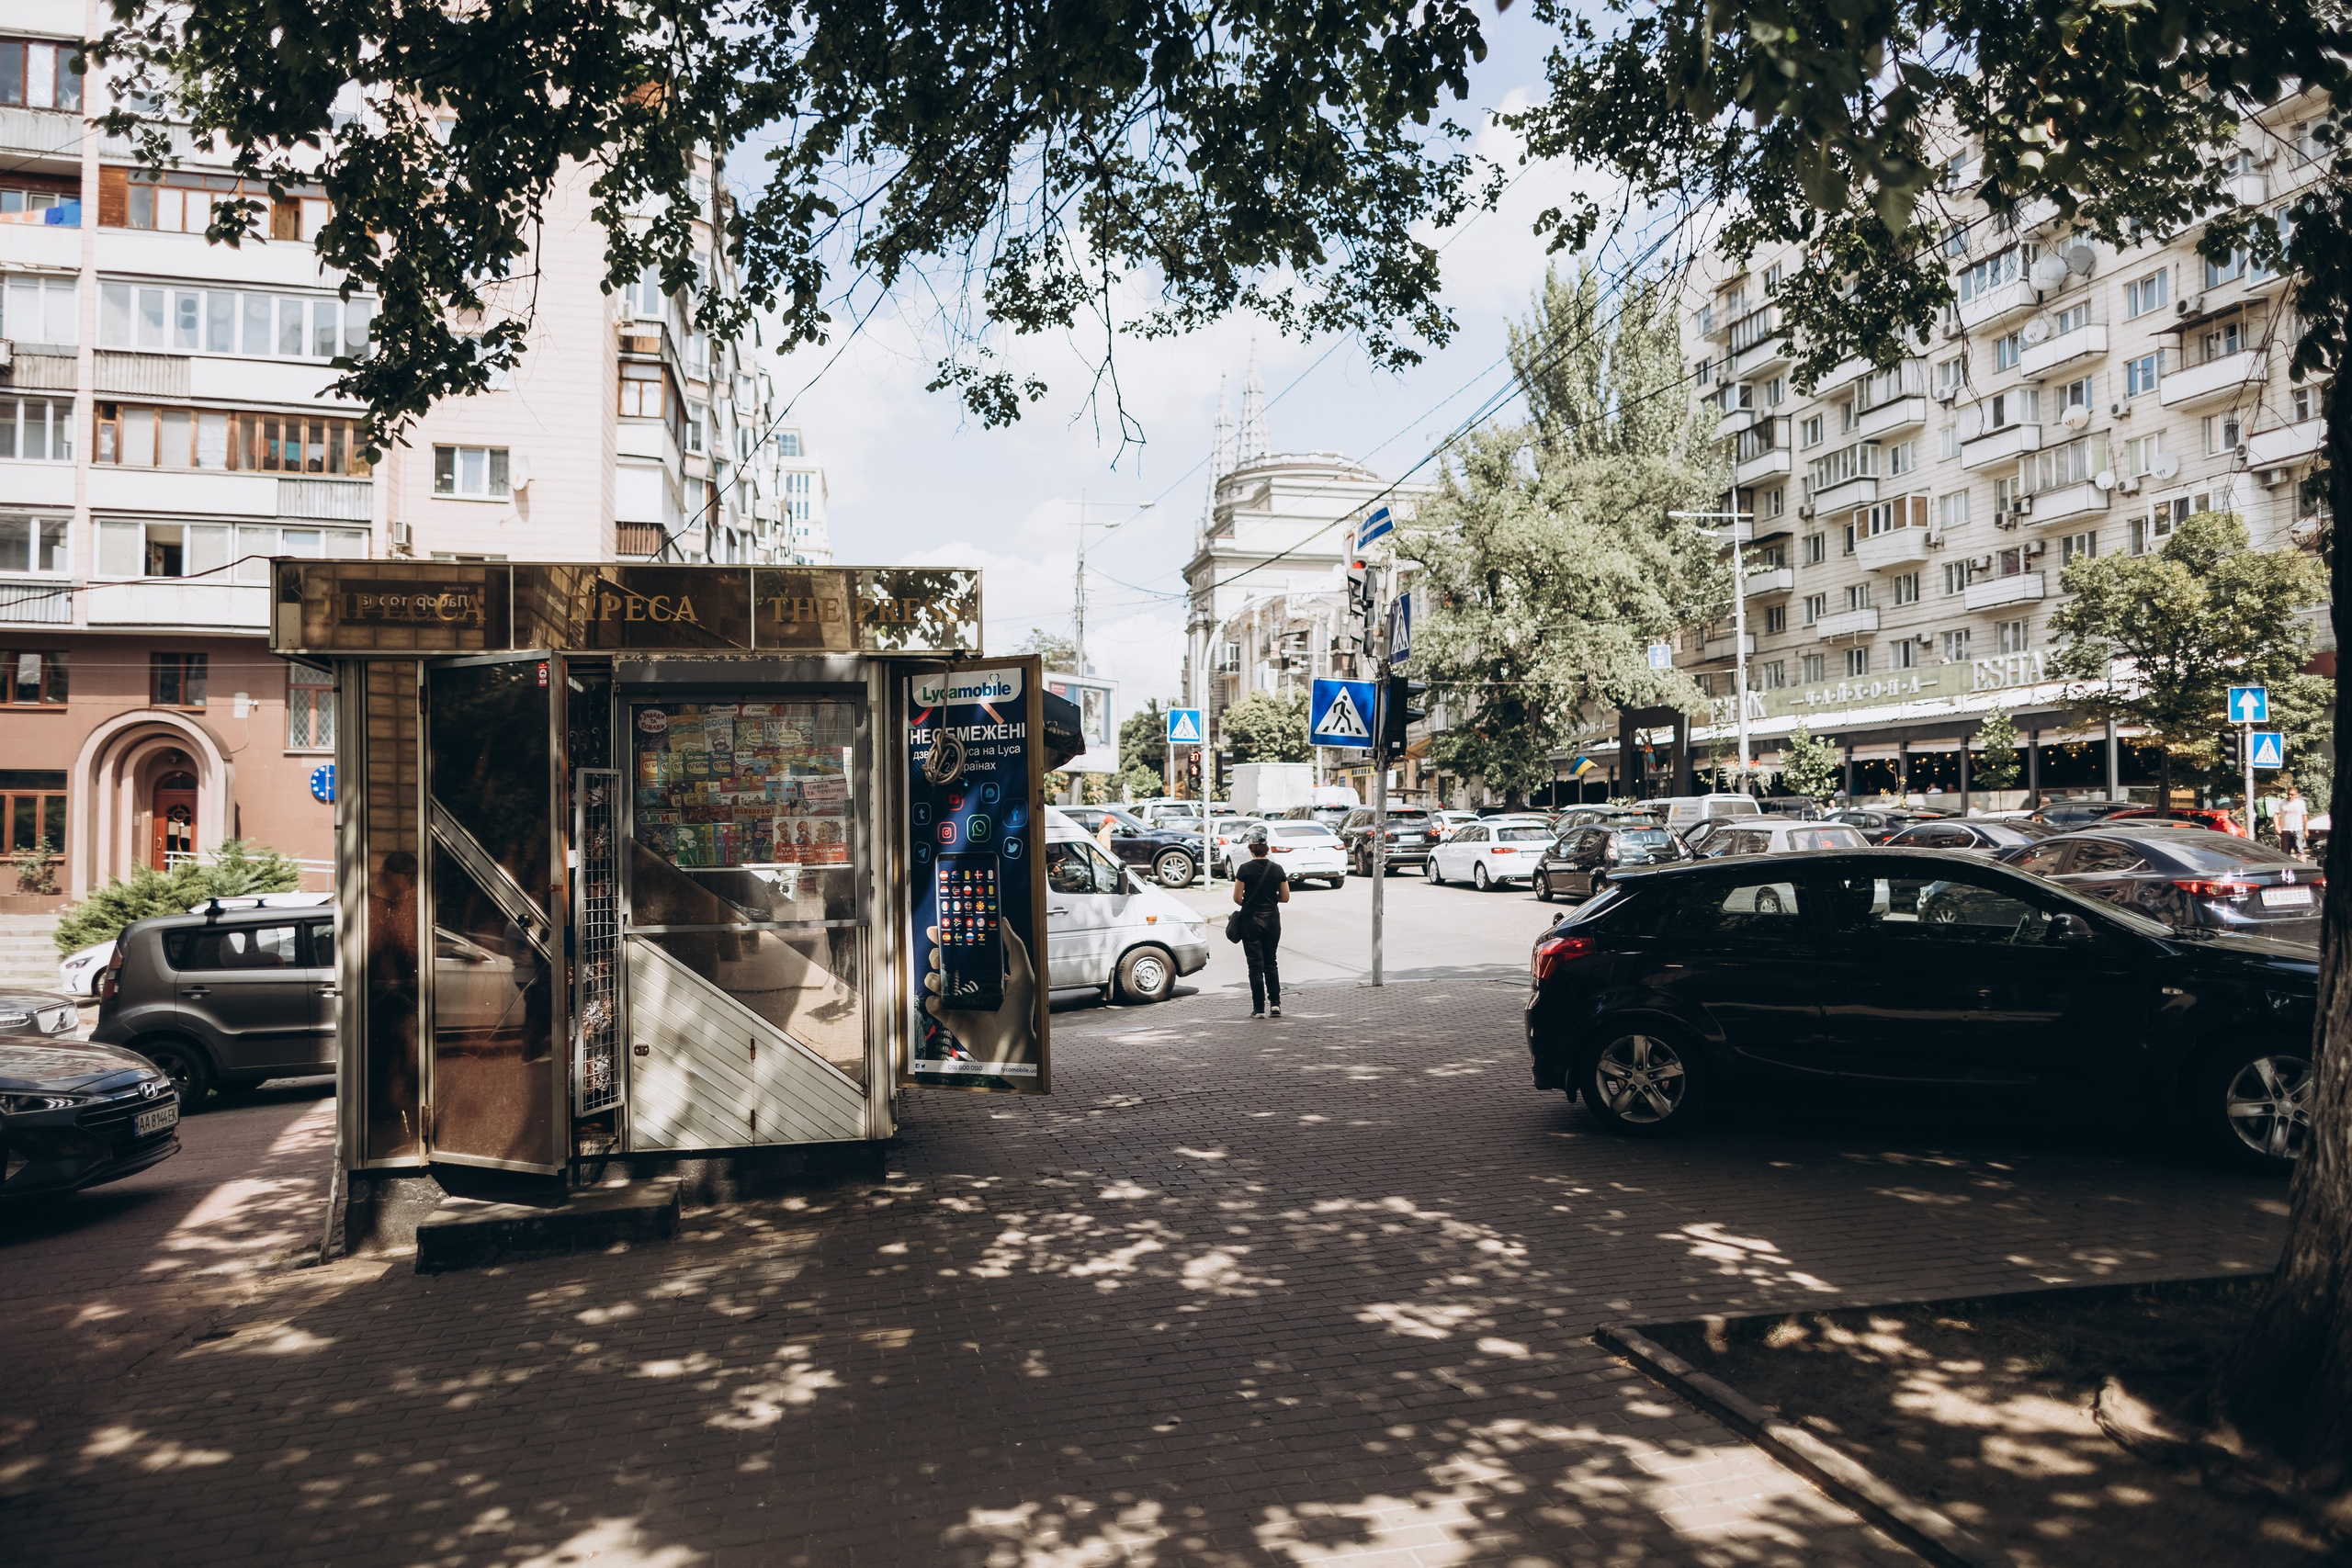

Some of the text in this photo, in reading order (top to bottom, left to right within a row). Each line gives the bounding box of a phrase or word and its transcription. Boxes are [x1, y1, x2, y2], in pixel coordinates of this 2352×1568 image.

[322, 592, 487, 621] ПРЕССА
[569, 593, 698, 622] ПРЕСА
[767, 596, 965, 624] THE PRESS
[1970, 647, 2069, 692] ESHA
[922, 682, 1012, 703] Lycamobile
[641, 722, 665, 730] ПОКАЖИ
[642, 712, 664, 720] ЗНАЙДИ
[910, 722, 1025, 745] НЕОБМЕЖЕНІ
[983, 746, 994, 756] на
[998, 743, 1021, 757] Lyca
[1190, 752, 1199, 761] 37
[964, 761, 996, 773] раїнах
[139, 1107, 177, 1133] AA 8144 EK
